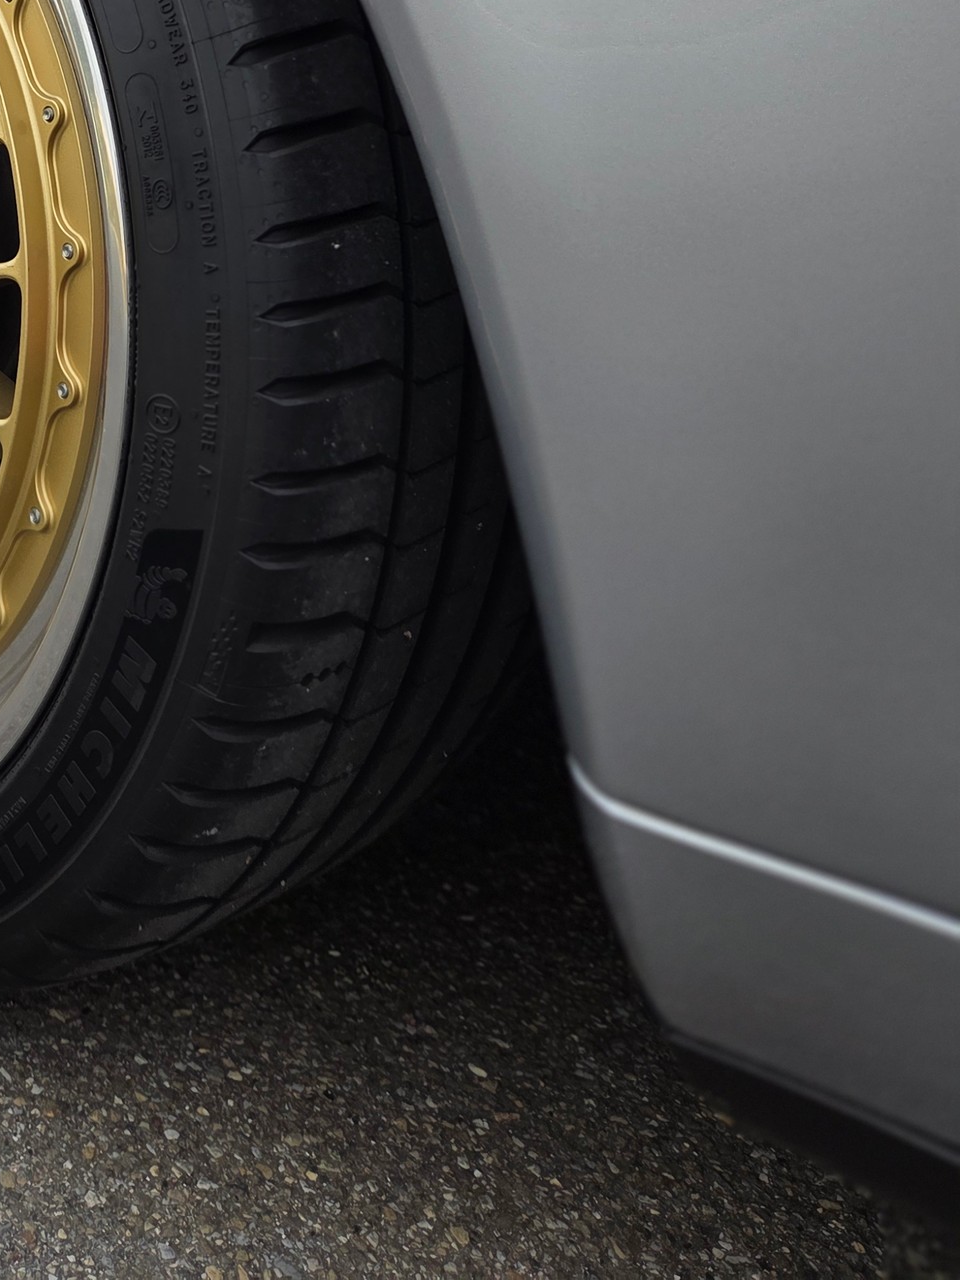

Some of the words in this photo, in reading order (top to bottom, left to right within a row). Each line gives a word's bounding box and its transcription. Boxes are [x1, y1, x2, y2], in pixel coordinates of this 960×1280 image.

[179, 78, 200, 115] 340
[192, 147, 218, 249] TRACTION
[202, 261, 221, 276] A
[200, 308, 222, 453] TEMPERATURE
[153, 401, 174, 426] E2
[196, 463, 214, 477] A
